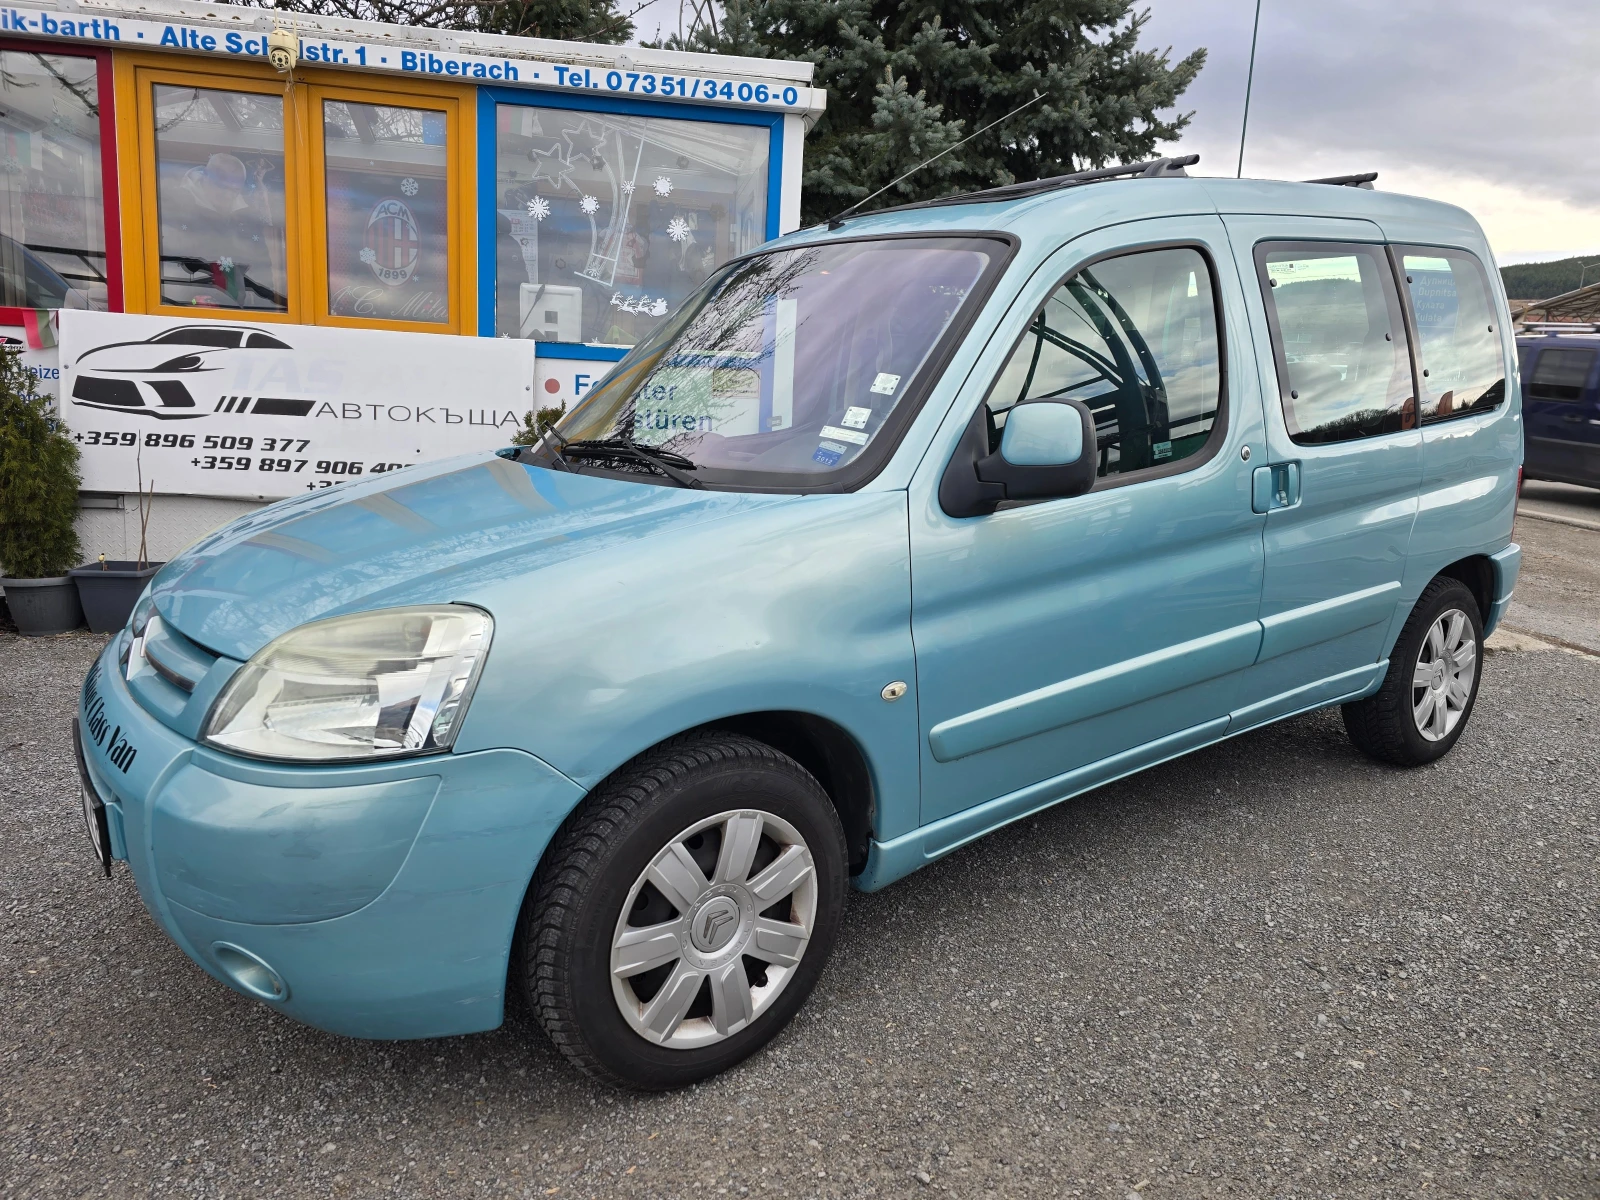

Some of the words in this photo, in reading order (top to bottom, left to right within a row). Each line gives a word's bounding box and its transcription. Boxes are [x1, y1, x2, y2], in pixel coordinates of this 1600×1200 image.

[161, 25, 217, 51] Alte
[401, 51, 518, 81] Biberach
[554, 66, 599, 88] Tel.
[606, 71, 798, 105] 07351/3406-0
[377, 203, 410, 221] ACM
[378, 267, 408, 280] 1899
[315, 402, 521, 429] АВТОКЪЩА
[74, 431, 138, 447] +359
[144, 433, 196, 448] 896
[203, 435, 254, 451] 509
[260, 437, 311, 453] 377
[191, 456, 252, 471] +359
[258, 458, 309, 473] 897
[315, 460, 364, 475] 906
[105, 725, 138, 774] Van
